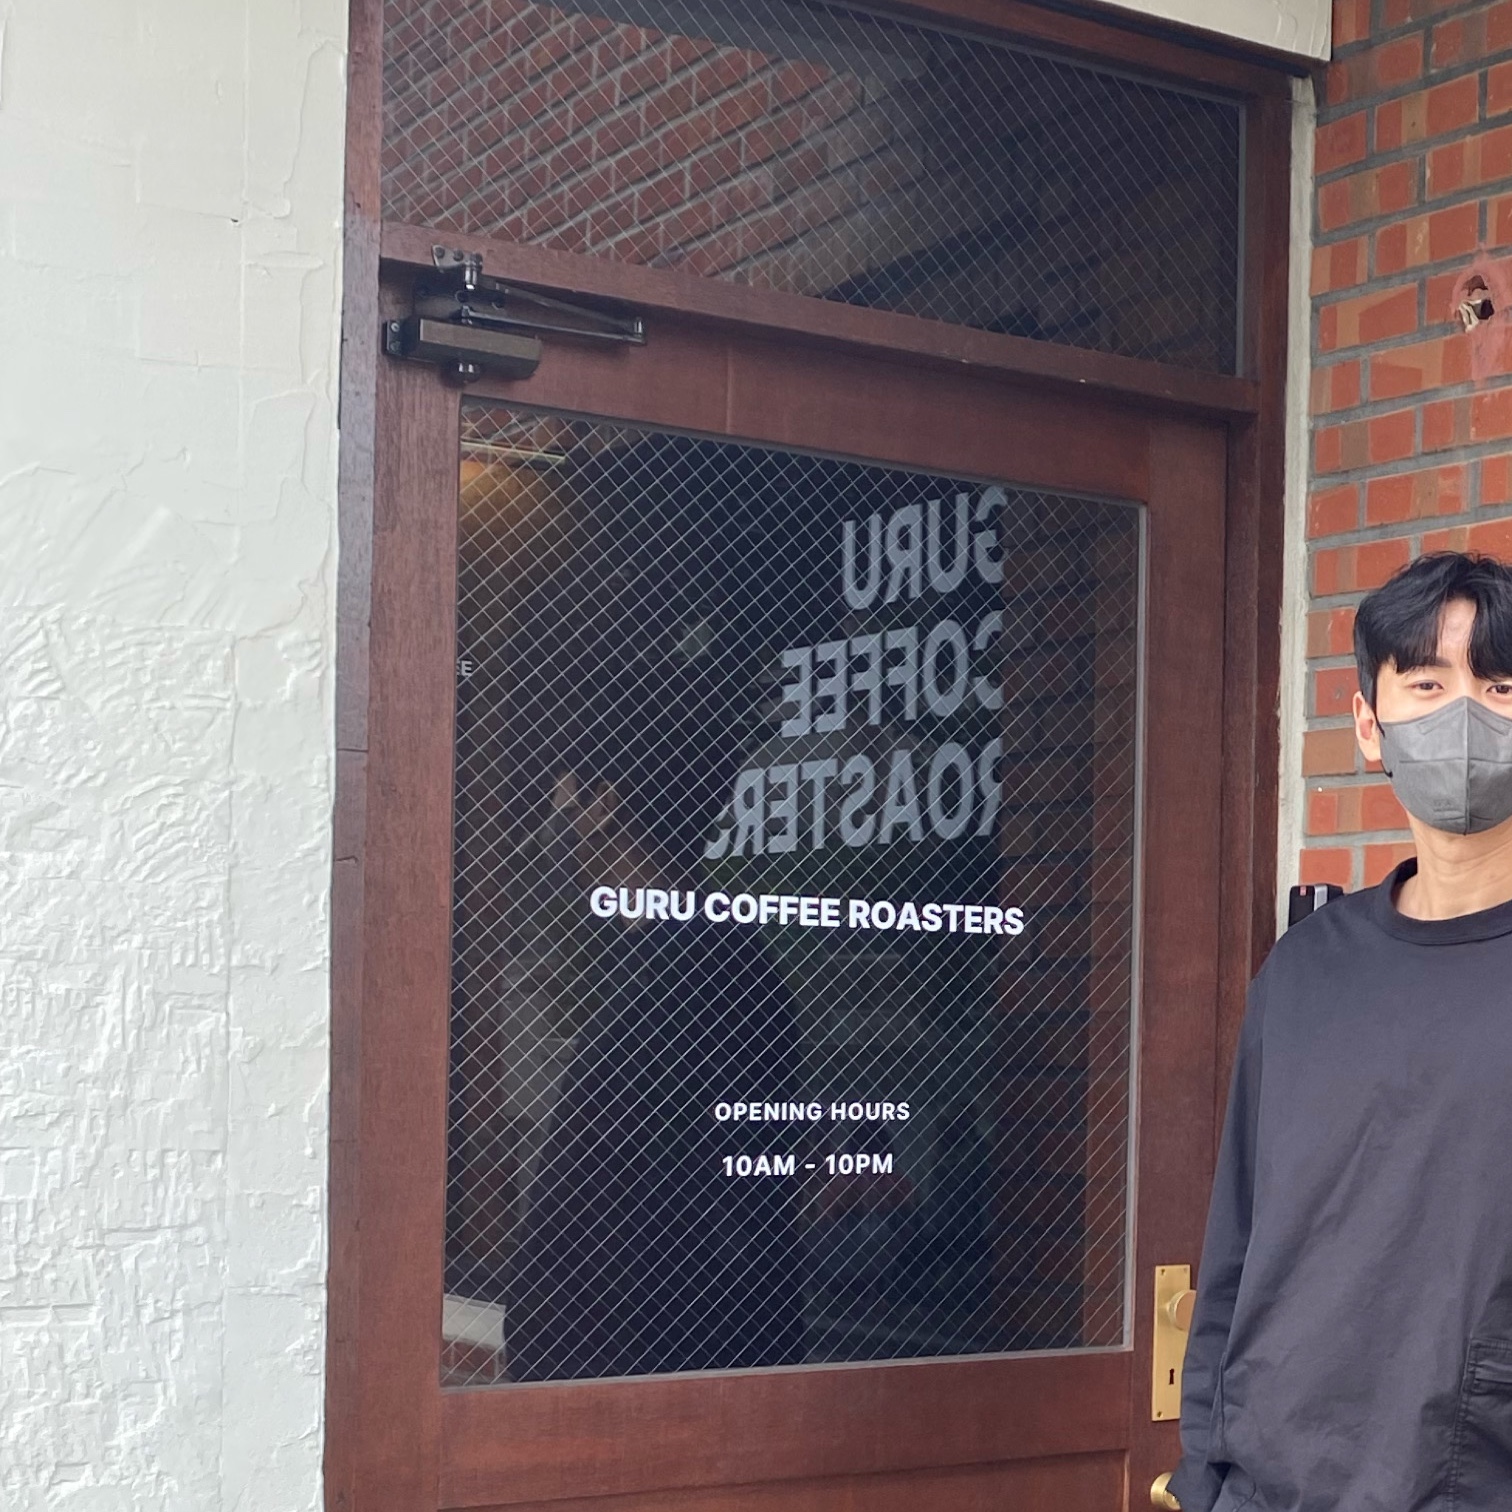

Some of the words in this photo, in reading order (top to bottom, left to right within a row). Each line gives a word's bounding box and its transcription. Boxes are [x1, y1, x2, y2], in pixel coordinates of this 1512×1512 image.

[589, 886, 695, 921] GURU
[704, 892, 841, 928] COFFEE
[848, 899, 1025, 936] ROASTERS
[714, 1102, 823, 1122] OPENING
[830, 1102, 910, 1121] HOURS
[721, 1154, 796, 1178] 10AM
[824, 1152, 894, 1176] 10PM
